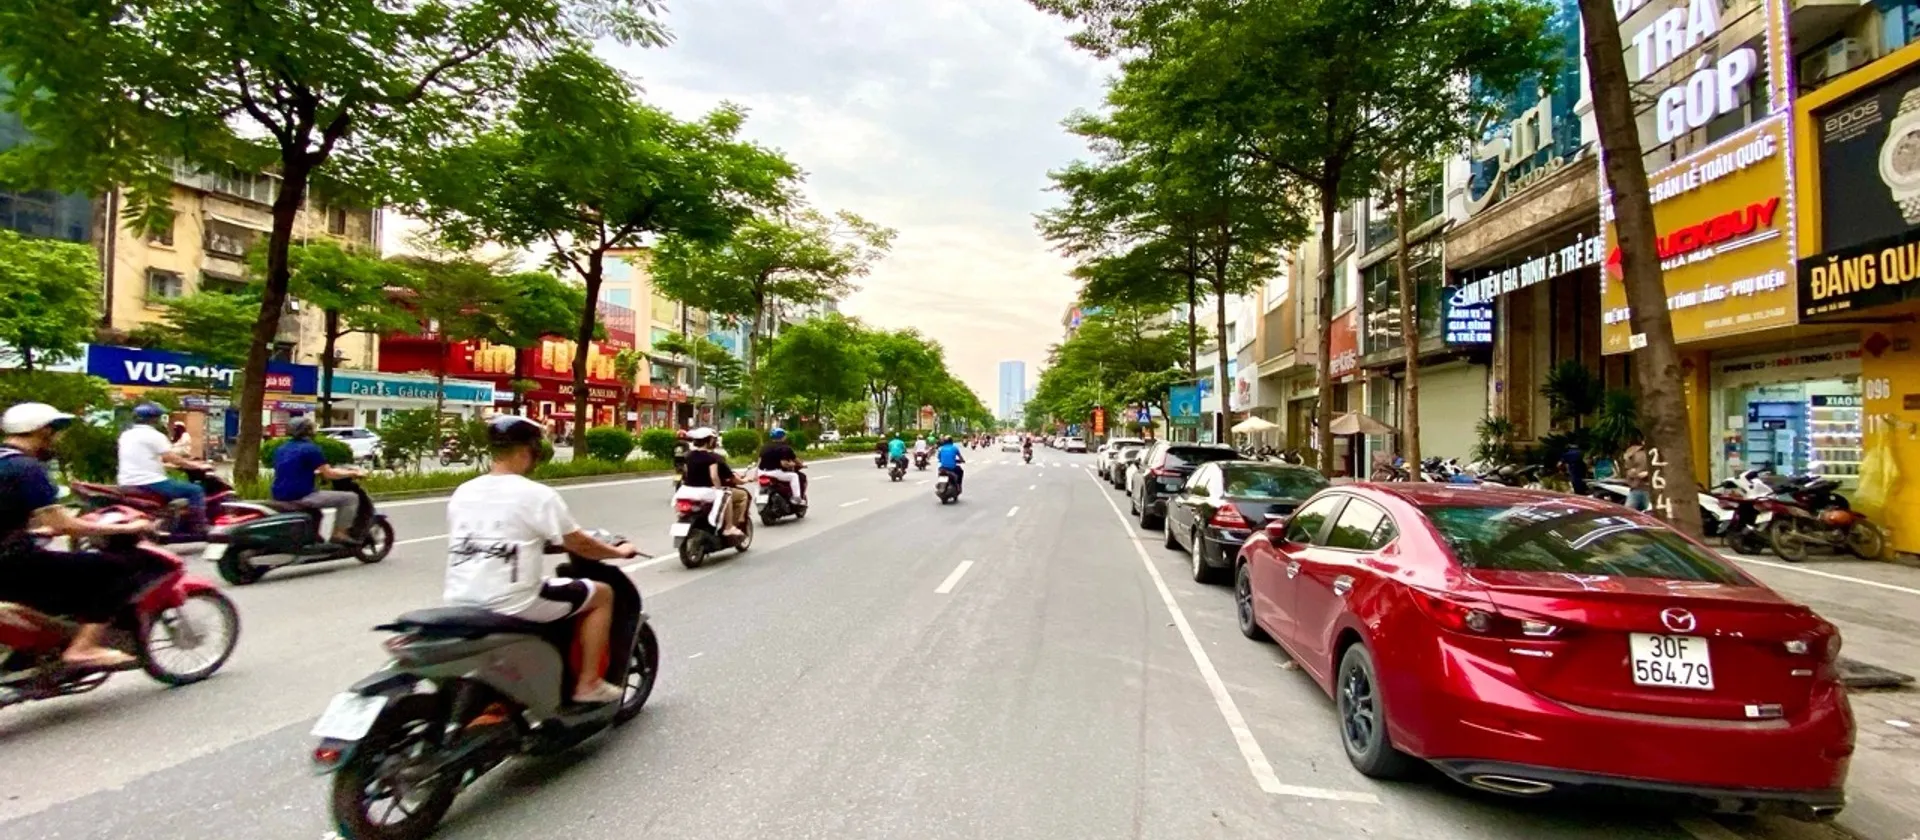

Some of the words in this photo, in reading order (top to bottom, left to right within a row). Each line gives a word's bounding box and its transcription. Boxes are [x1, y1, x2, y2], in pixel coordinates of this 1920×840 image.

[1656, 48, 1757, 143] GÓP
[1825, 100, 1879, 131] epos
[1502, 267, 1518, 293] GIA
[1547, 253, 1557, 278] &
[1560, 233, 1583, 274] TRẺ
[1810, 254, 1876, 300] ĐĂNG
[1866, 378, 1890, 400] 096
[1650, 636, 1689, 659] 30F
[1636, 660, 1710, 686] 564.79
